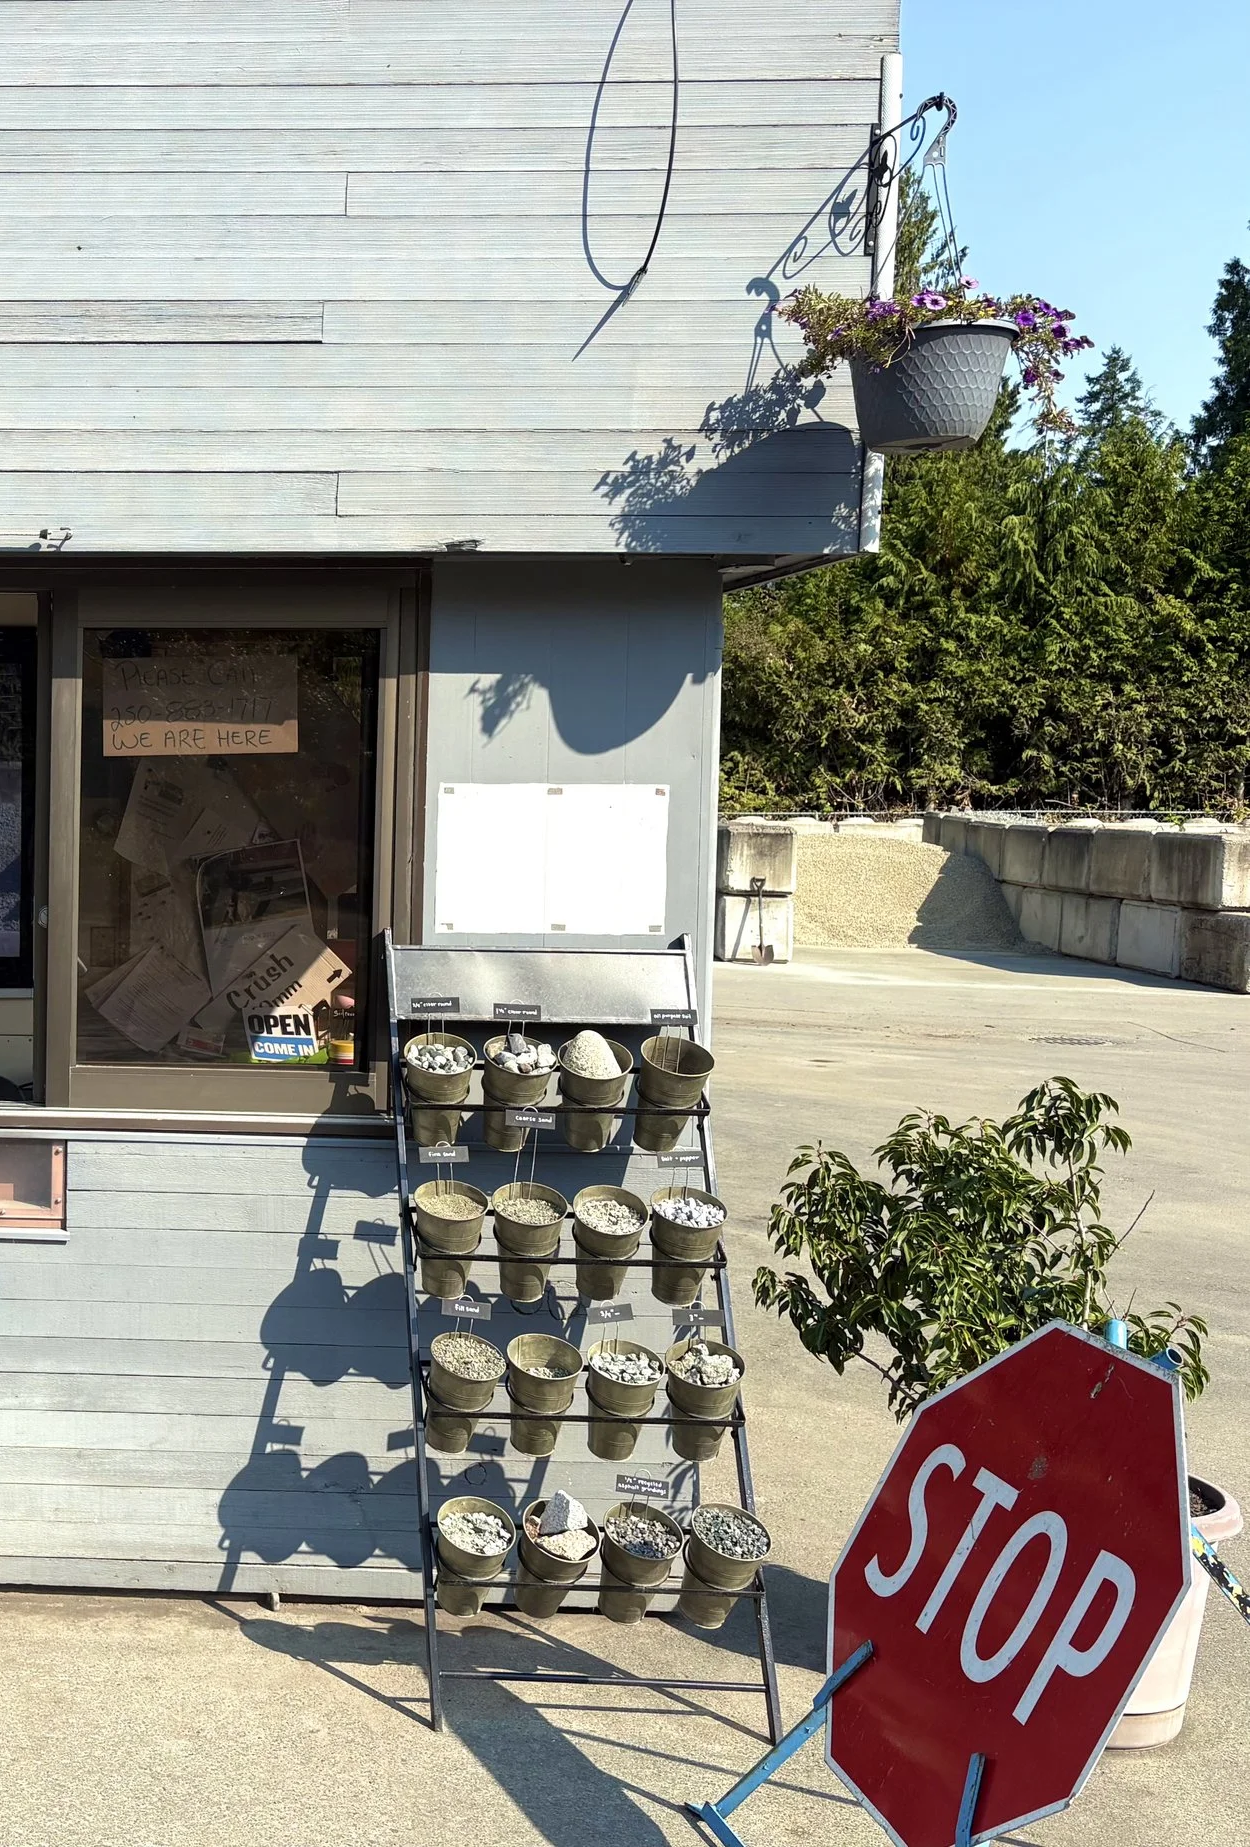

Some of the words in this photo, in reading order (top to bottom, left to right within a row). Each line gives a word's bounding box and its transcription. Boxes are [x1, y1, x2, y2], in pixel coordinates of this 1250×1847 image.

[112, 732, 153, 750] WE
[164, 728, 206, 750] ARE
[218, 728, 273, 748] HERE
[226, 953, 294, 1010] Crush
[248, 1014, 311, 1036] OPEN
[254, 1041, 296, 1056] COME
[298, 1044, 315, 1057] IN
[864, 1443, 1137, 1726] STOP
